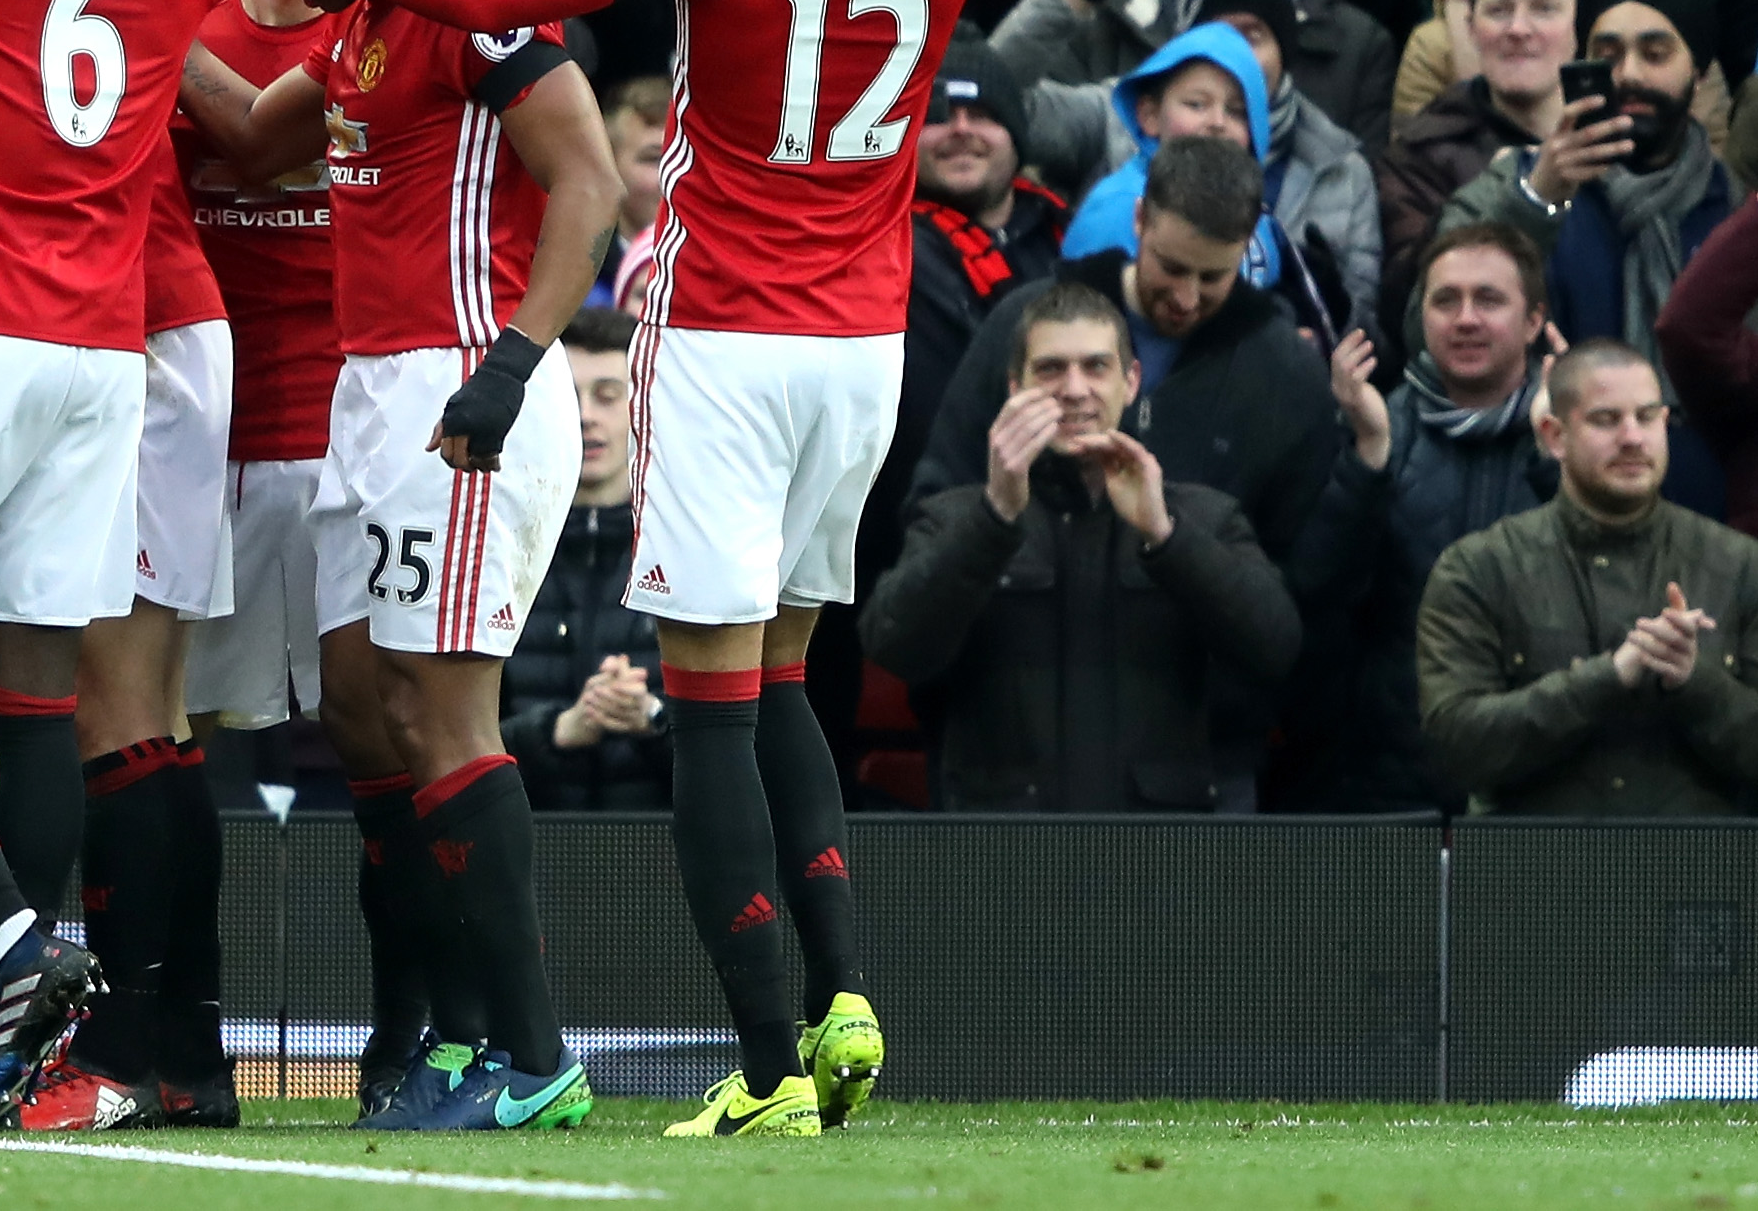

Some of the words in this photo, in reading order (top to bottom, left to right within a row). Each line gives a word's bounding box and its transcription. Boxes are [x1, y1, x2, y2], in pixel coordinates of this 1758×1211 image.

[366, 521, 438, 607] 25
[637, 580, 671, 595] adidas
[487, 618, 517, 631] adidas
